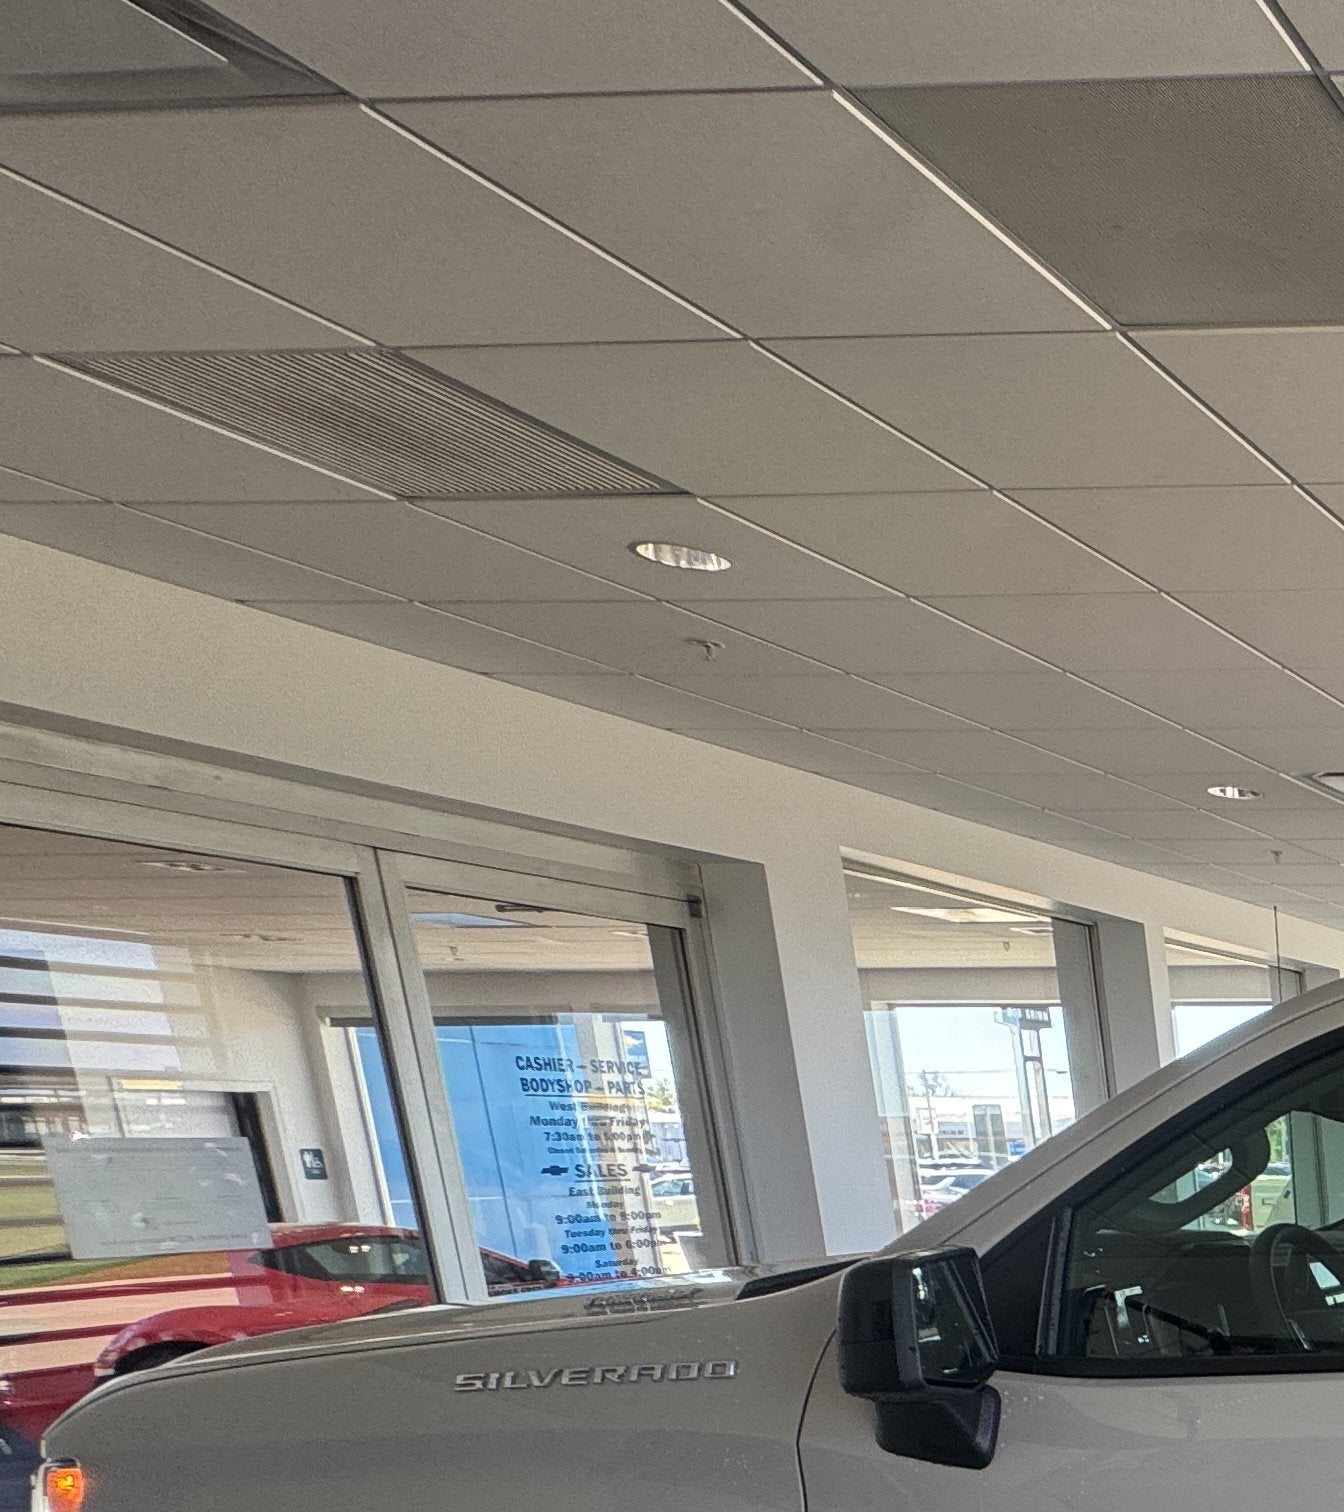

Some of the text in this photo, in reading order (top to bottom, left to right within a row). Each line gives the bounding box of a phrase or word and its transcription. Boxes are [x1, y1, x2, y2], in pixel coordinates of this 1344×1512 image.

[515, 1055, 575, 1073] CASHIER
[590, 1059, 643, 1076] SERVICE
[520, 1077, 592, 1094] BODYSHOP
[529, 1115, 578, 1130] Monday
[575, 1164, 628, 1179] SALES
[564, 1228, 606, 1239] Tuesday
[453, 1360, 738, 1392] SILVERADO
